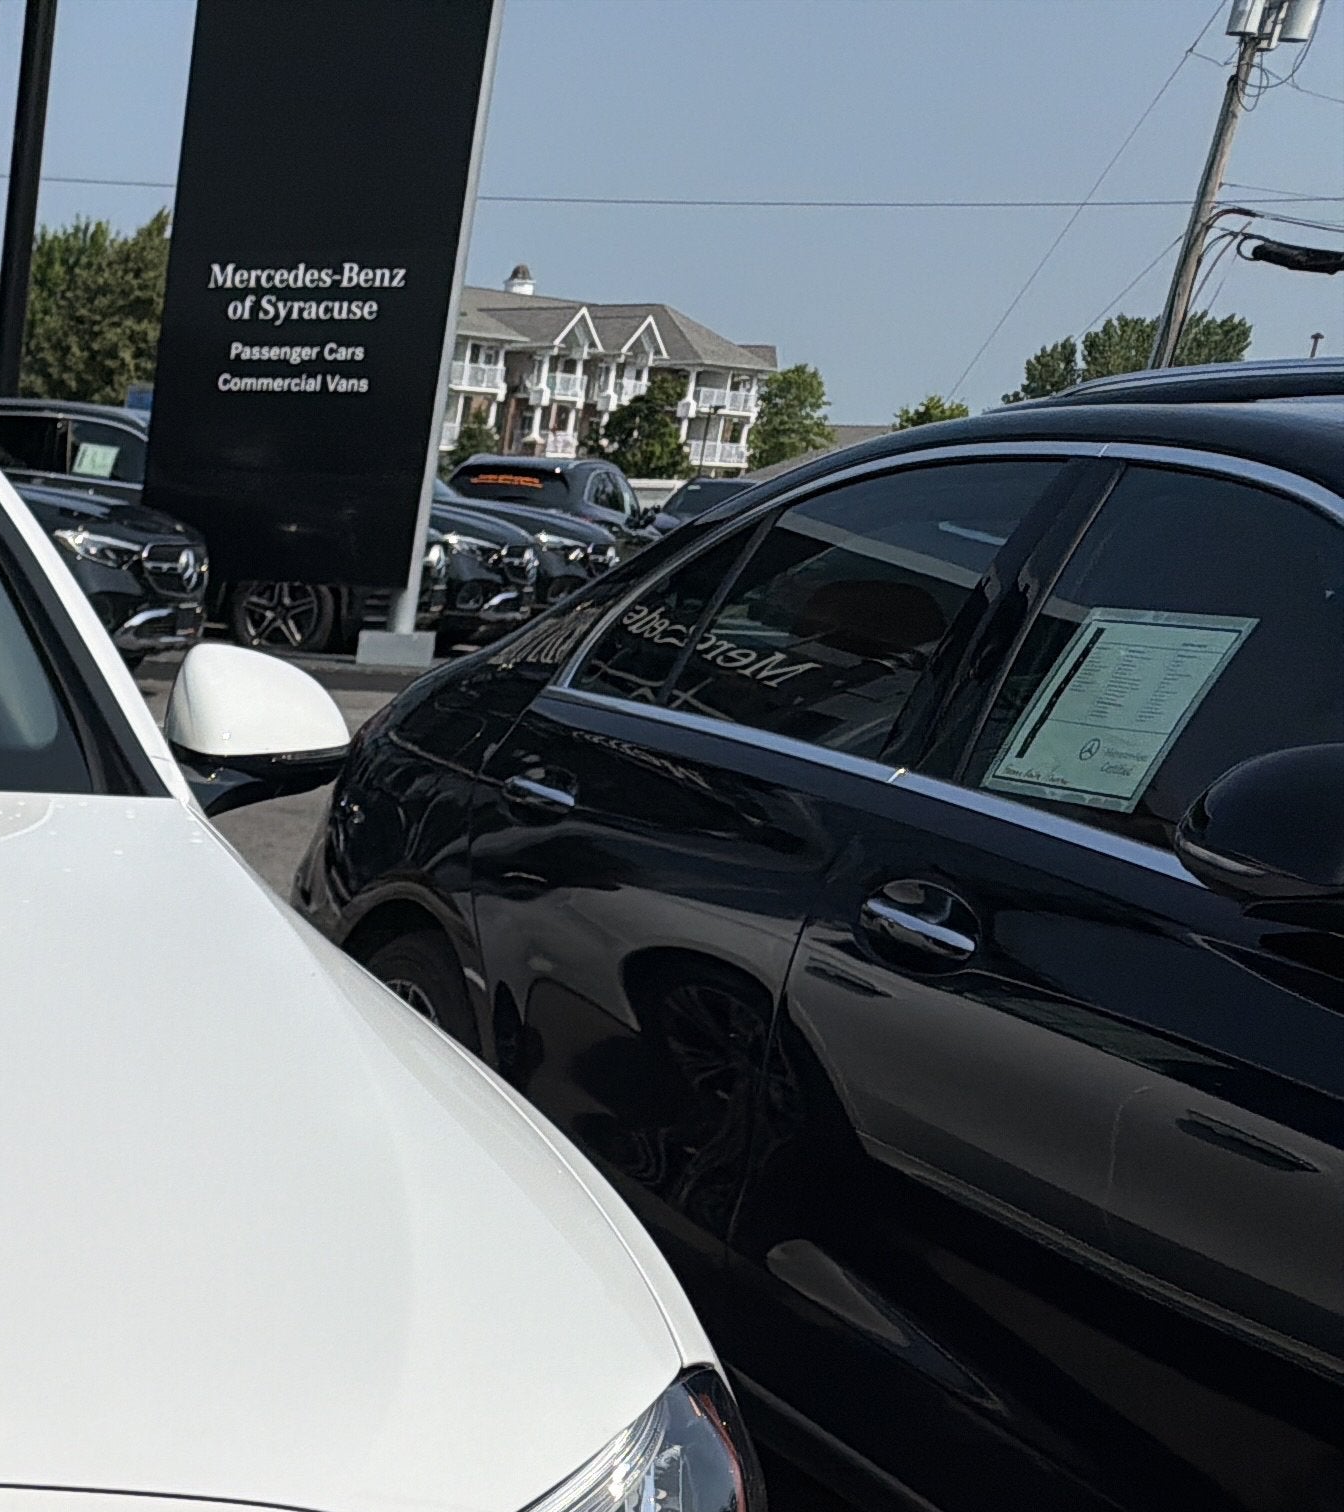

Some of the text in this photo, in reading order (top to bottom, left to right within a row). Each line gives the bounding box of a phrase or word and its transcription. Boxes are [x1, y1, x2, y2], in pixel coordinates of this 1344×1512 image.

[207, 262, 407, 289] Mercedes-Benz
[227, 294, 379, 326] of Syracuse
[229, 341, 365, 365] Passenger Cars
[217, 372, 369, 393] Commercial Vans
